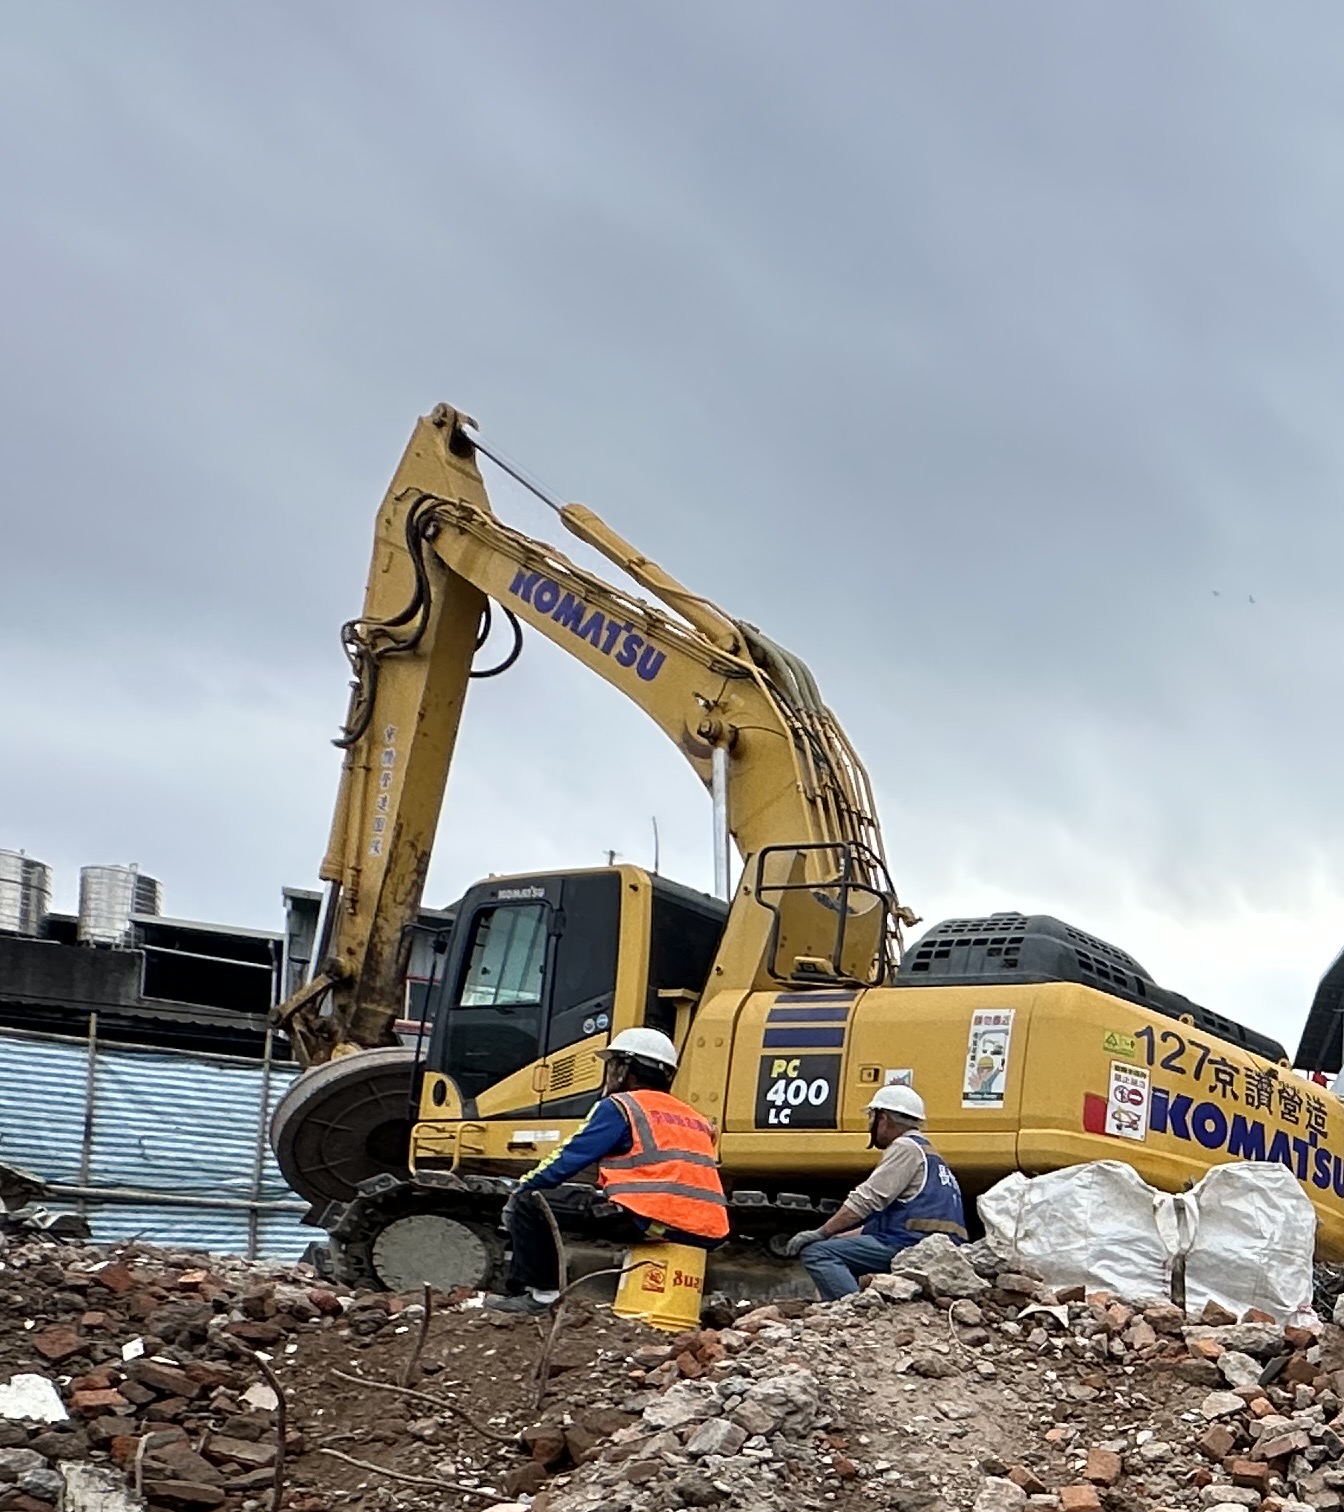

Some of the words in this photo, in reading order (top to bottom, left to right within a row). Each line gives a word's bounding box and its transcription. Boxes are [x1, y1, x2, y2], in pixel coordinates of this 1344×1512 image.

[508, 570, 667, 682] KOMATSU
[770, 1058, 802, 1078] PC
[766, 1078, 830, 1106] 400
[767, 1107, 792, 1125] LC
